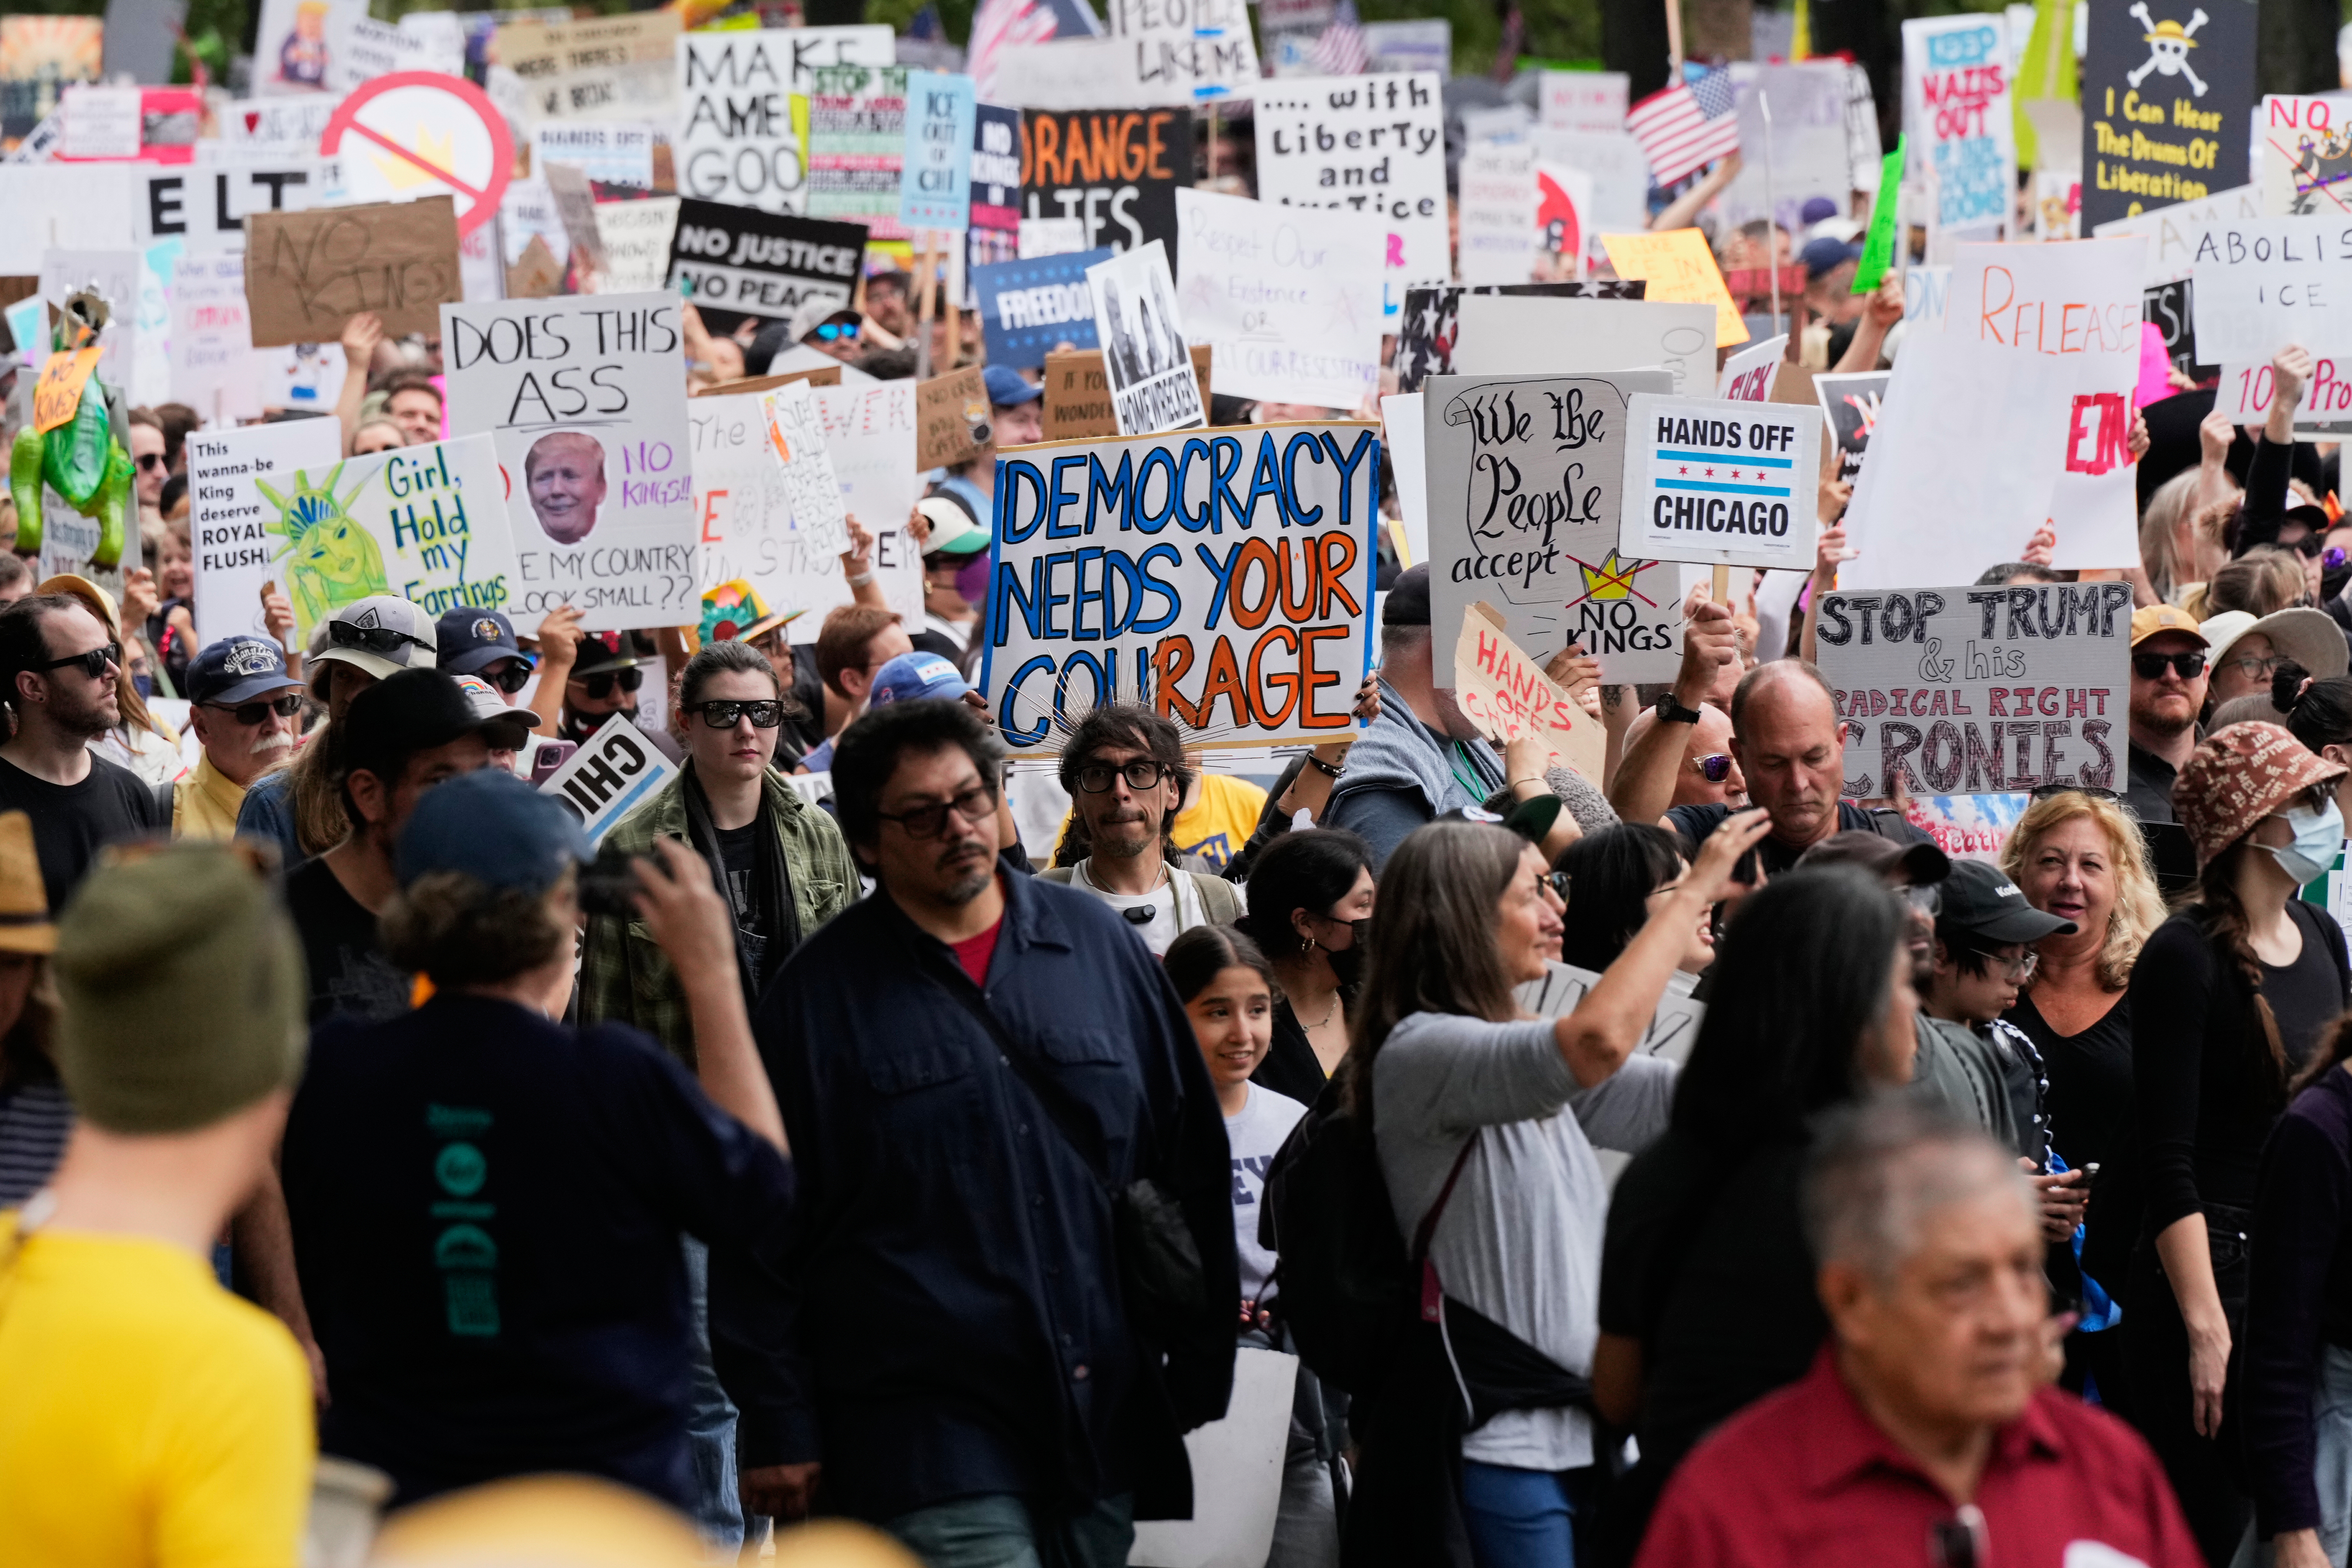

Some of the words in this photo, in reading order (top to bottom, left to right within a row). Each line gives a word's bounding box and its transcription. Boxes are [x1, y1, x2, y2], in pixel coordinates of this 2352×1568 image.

[925, 89, 956, 118] ICE
[1329, 79, 1430, 110] with
[1922, 65, 2007, 109] NAZIS
[1935, 100, 1990, 140] OUT
[2104, 86, 2115, 117] I
[2123, 89, 2165, 124] Can
[2173, 97, 2223, 133] Hear
[2270, 99, 2331, 131] NO
[922, 122, 957, 144] OUT
[2093, 120, 2131, 157] The
[2131, 129, 2189, 167] Drums
[2188, 137, 2220, 170] Of
[1319, 157, 1390, 187] and
[2096, 159, 2208, 202] Liberation
[679, 224, 730, 257] NO
[729, 232, 858, 277] JUSTICE
[1272, 221, 1328, 270] Our
[682, 270, 728, 298] NO
[2259, 283, 2327, 307] ICE
[452, 314, 570, 370] DOES
[580, 307, 678, 356] THIS
[1241, 310, 1276, 332] OR
[508, 365, 629, 425] ASS
[688, 415, 746, 451] The
[1473, 391, 1534, 446] We
[1542, 388, 1606, 454] the
[1657, 416, 1741, 449] HANDS
[1749, 423, 1794, 452] OFF
[196, 443, 228, 457] This
[197, 458, 274, 480] wanna-be
[622, 441, 673, 475] NO
[199, 485, 234, 501] King
[386, 445, 462, 500] Girl,
[622, 476, 692, 508] KINGS!!
[1003, 429, 1374, 544] DEMOCRACY
[1474, 453, 1602, 547] People
[1653, 495, 1789, 536] CHICAGO
[202, 522, 266, 547] ROYAL
[390, 494, 469, 550] Hold
[421, 540, 467, 581] my
[550, 551, 585, 581] MY
[591, 545, 696, 580] COUNTRY
[754, 528, 922, 576] STER
[1451, 542, 1561, 588] accept
[404, 574, 508, 618] Earrings
[993, 542, 1183, 647] NEEDS
[1195, 530, 1362, 631] YOUR
[1580, 601, 1637, 631] NO
[1817, 591, 1946, 646] STOP
[1967, 584, 2130, 640] TRUMP
[1566, 623, 1672, 656] KINGS
[1919, 638, 1955, 683] &
[1965, 640, 2026, 679] his
[998, 624, 1352, 748] COURAGE
[1477, 630, 1572, 731] HANDS
[1496, 689, 1545, 732] OFF
[1835, 688, 1972, 717] RADICAL
[1988, 687, 2111, 718] RIGHT
[1842, 719, 2116, 799] CRONIES
